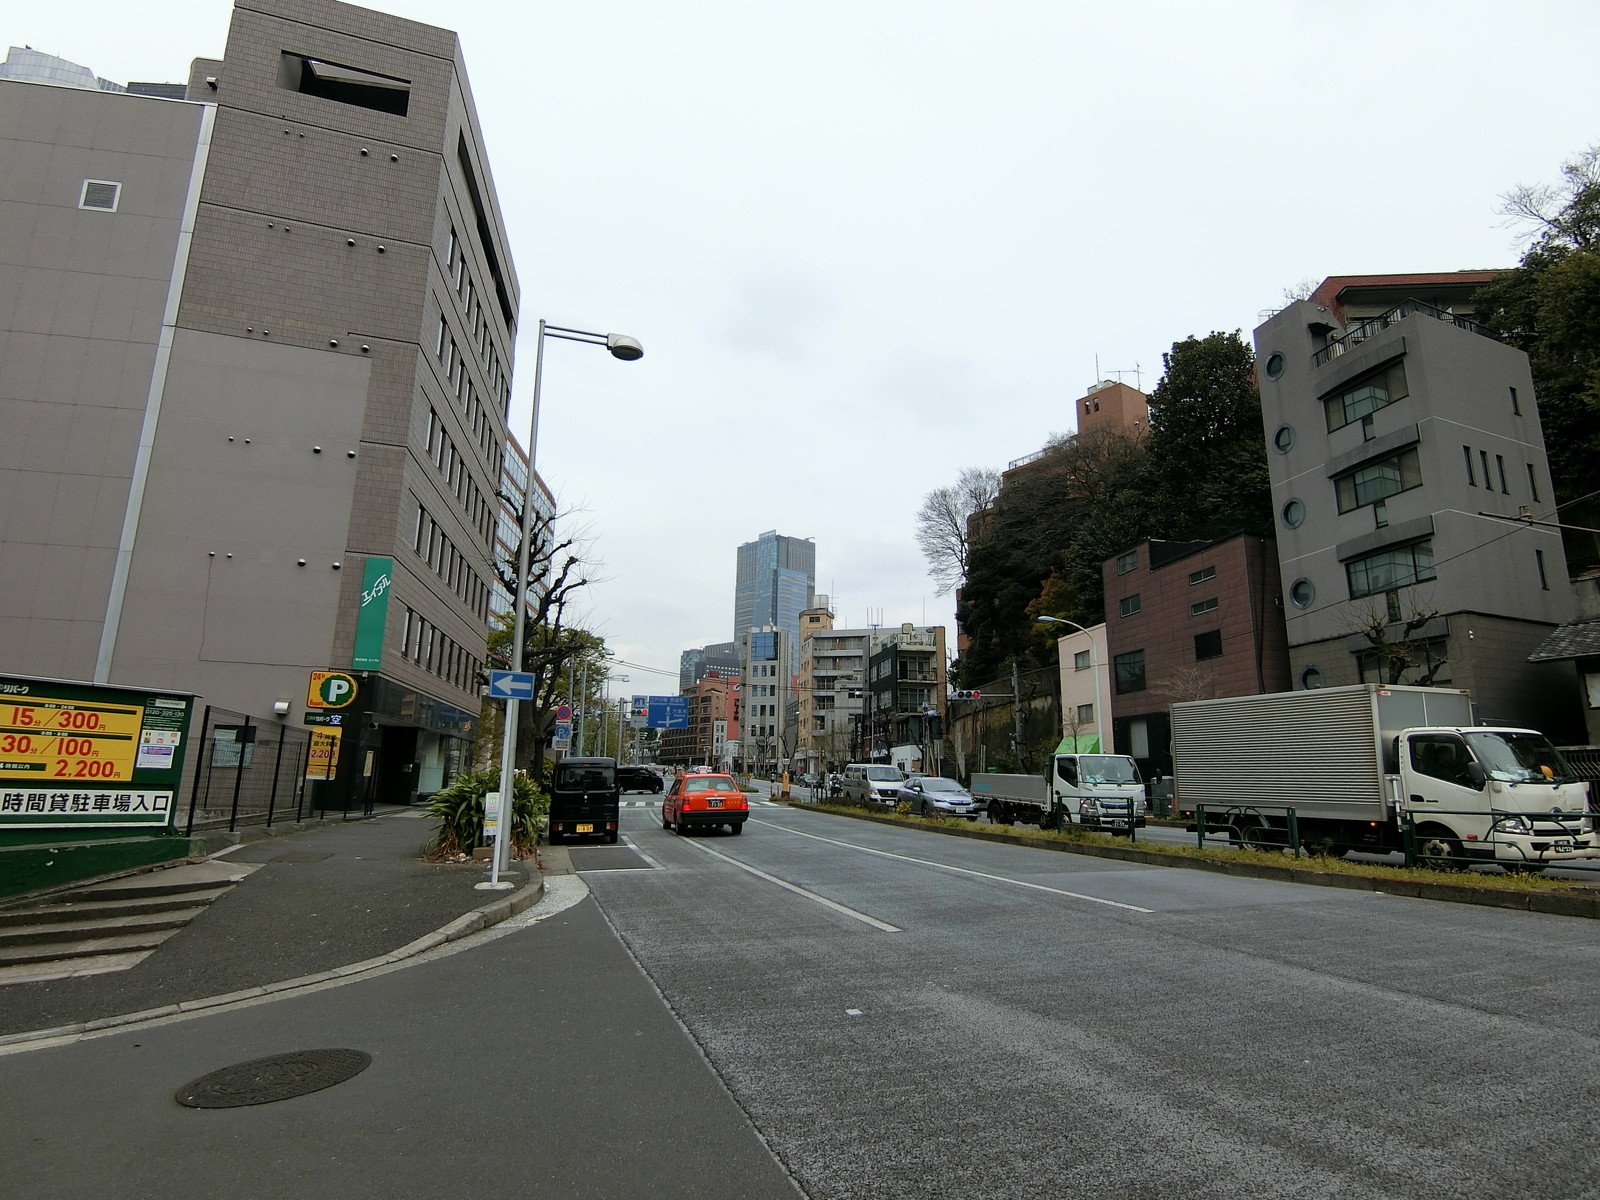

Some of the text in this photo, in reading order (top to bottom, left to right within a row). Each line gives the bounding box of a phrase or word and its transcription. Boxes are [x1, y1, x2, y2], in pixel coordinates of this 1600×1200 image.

[361, 574, 391, 607] エイブル
[329, 679, 349, 702] P
[1, 792, 170, 813] 時間貸駐車場入口
